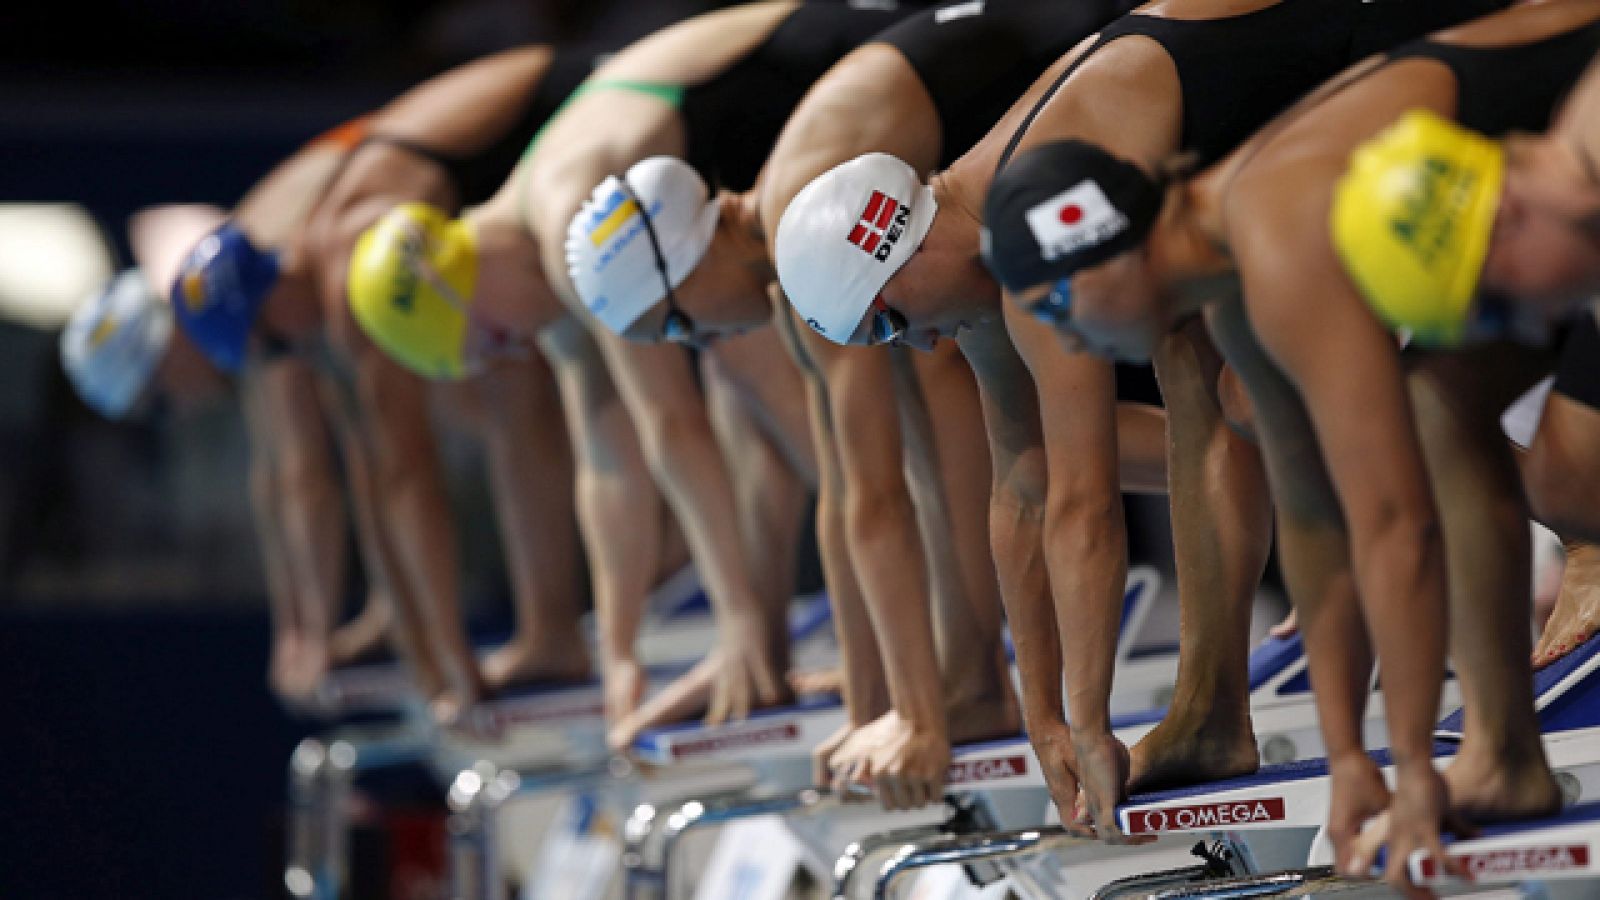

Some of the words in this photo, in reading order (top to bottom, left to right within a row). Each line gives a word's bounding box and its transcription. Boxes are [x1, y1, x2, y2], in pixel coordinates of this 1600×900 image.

[875, 205, 910, 262] DEN
[944, 758, 1012, 783] MEGA
[1175, 801, 1270, 829] OMEGA
